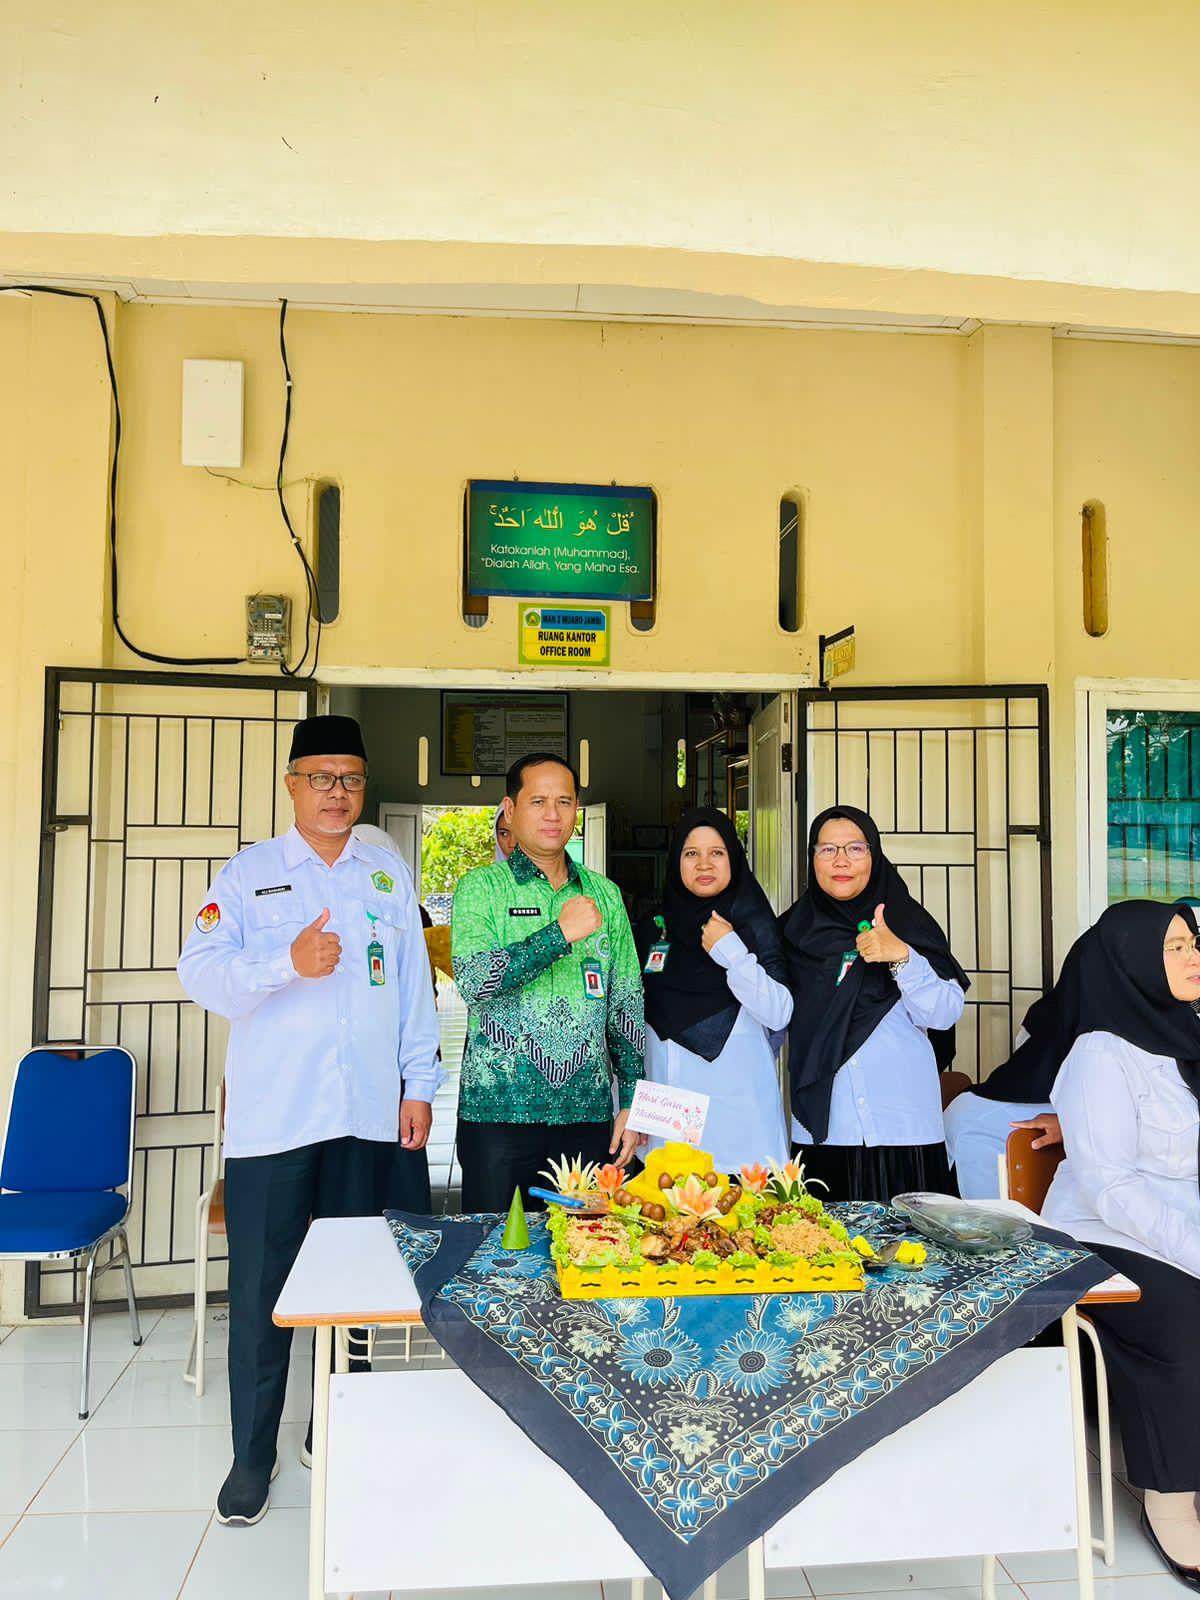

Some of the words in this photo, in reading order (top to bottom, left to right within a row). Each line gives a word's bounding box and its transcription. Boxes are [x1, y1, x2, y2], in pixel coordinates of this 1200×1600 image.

[490, 543, 551, 557] Katakanlah
[554, 560, 582, 574] Yang
[584, 563, 617, 573] Maha
[538, 631, 564, 642] RUANG
[566, 632, 597, 643] KANTOR
[540, 646, 567, 657] OFFICE
[568, 647, 591, 657] ROOM
